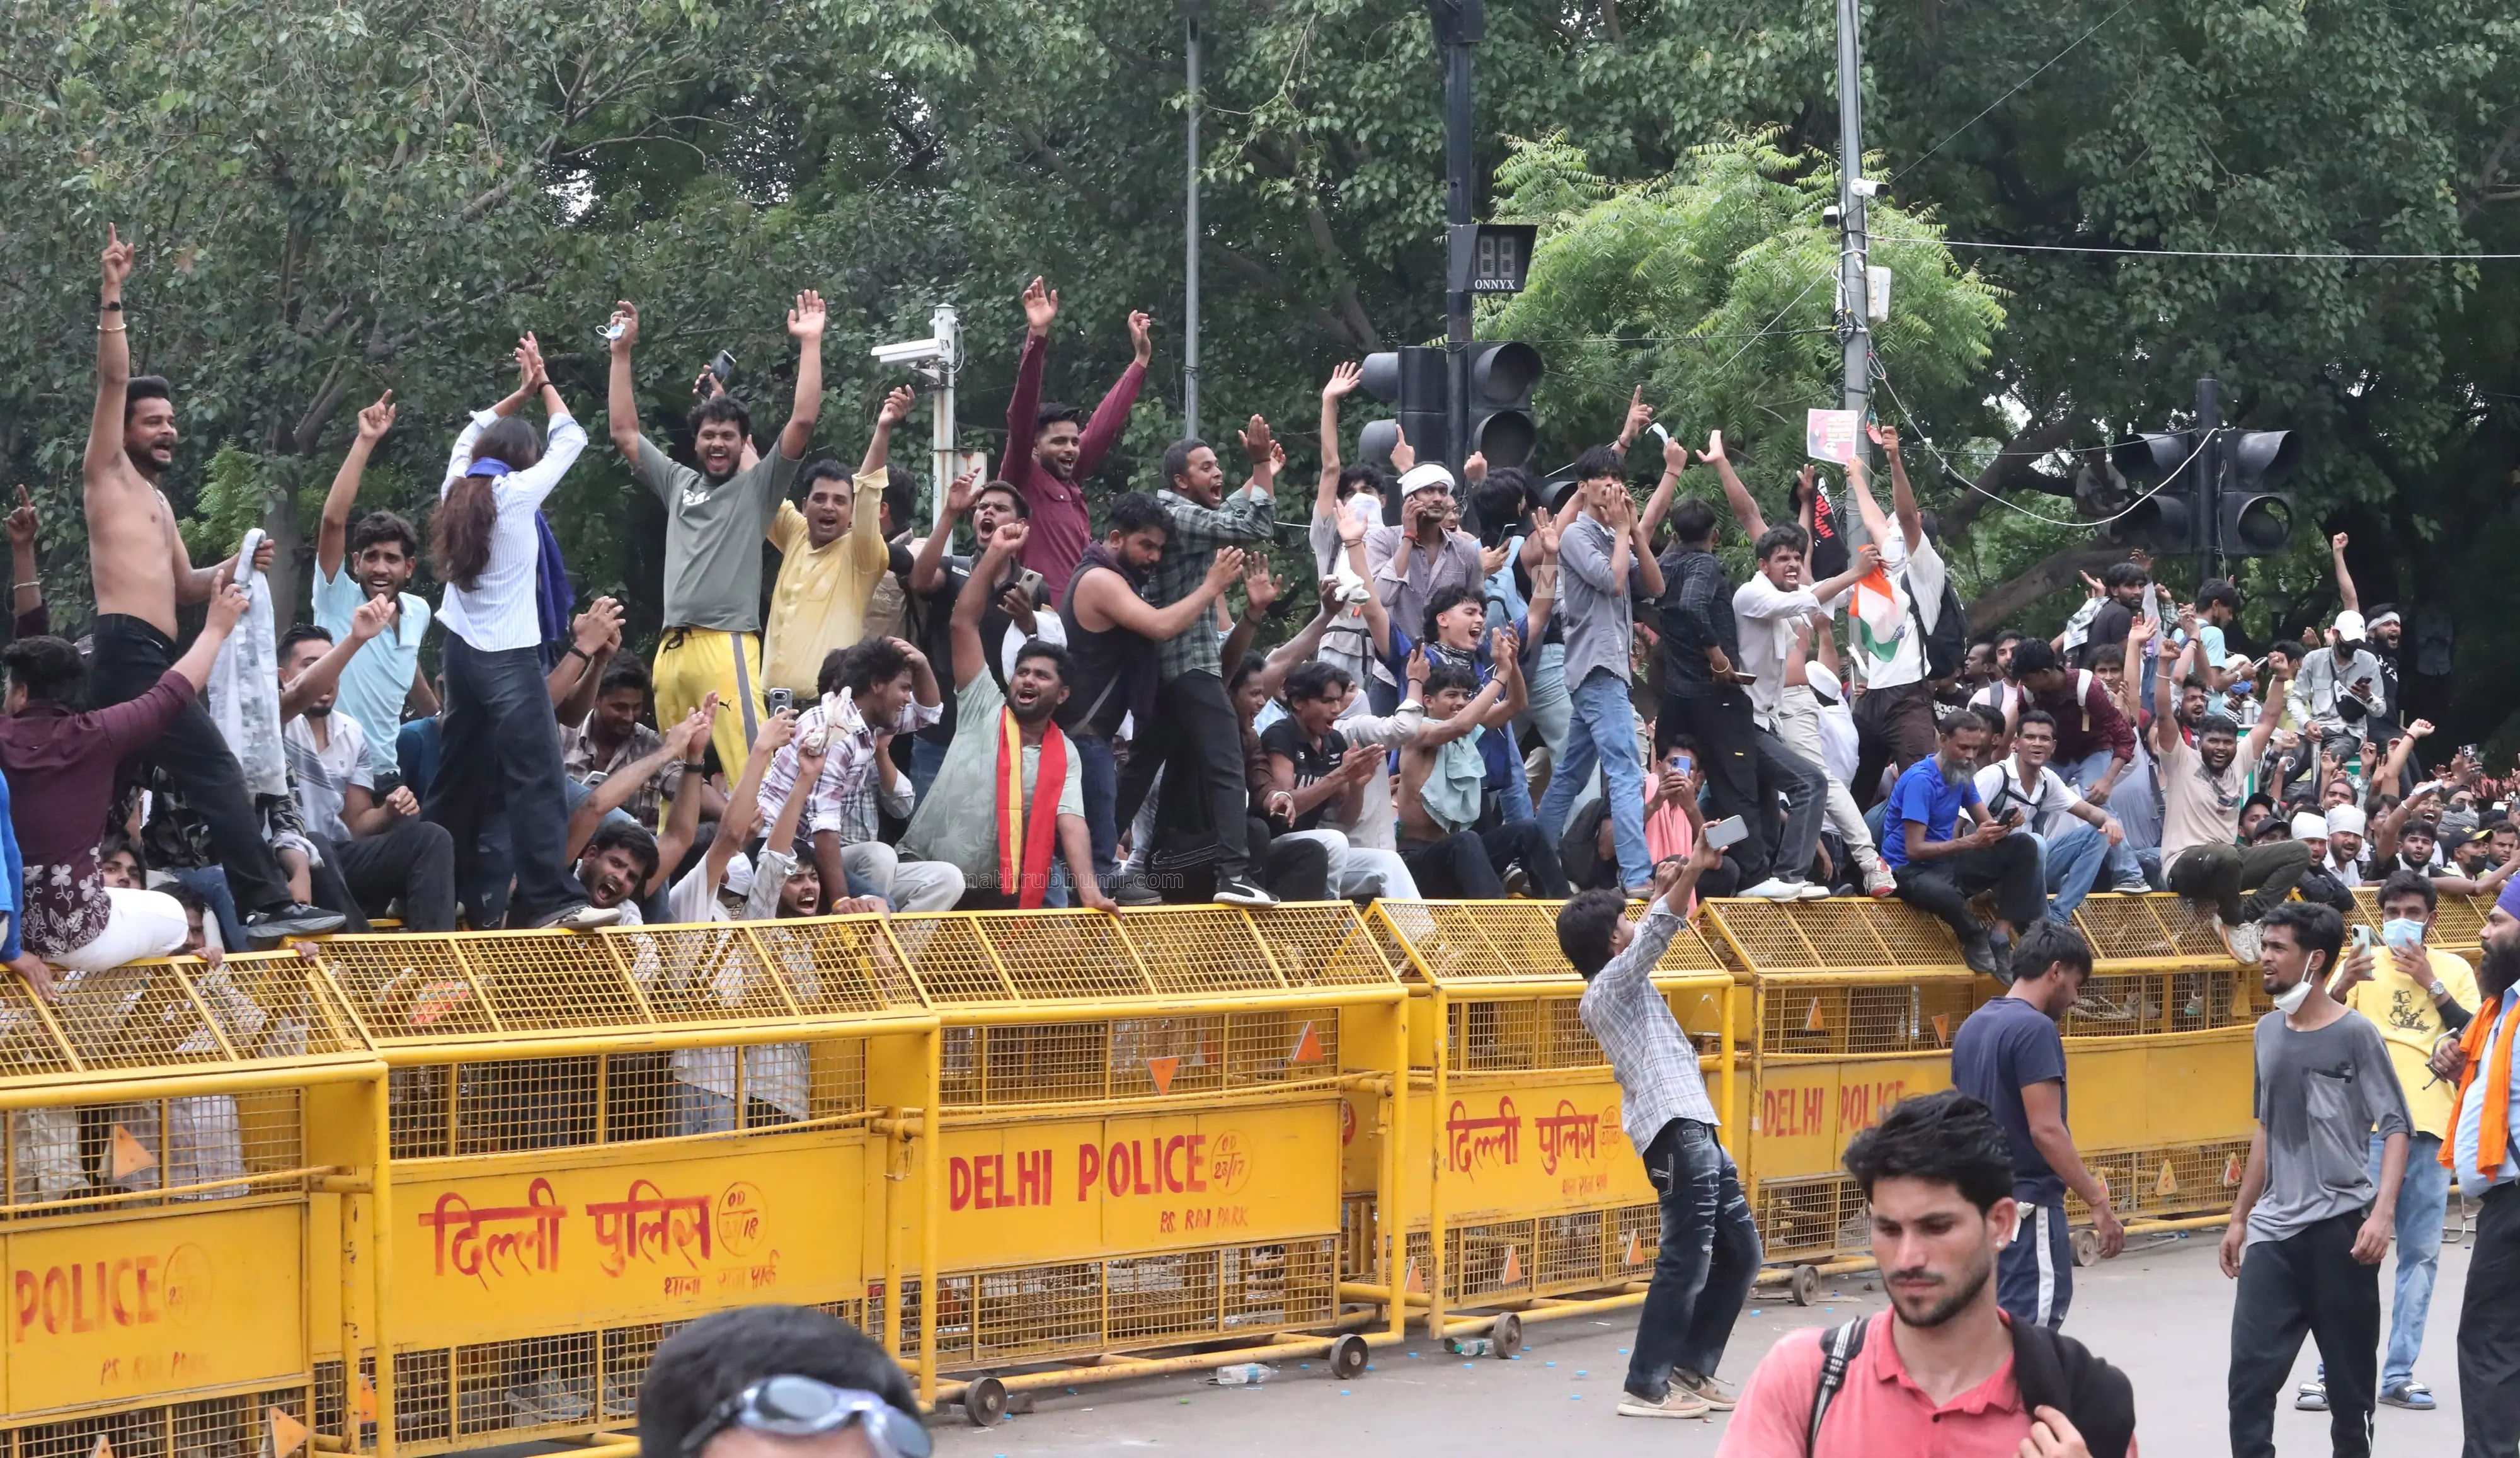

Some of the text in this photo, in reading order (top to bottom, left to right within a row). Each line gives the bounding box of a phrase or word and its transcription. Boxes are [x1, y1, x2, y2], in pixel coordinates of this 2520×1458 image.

[1475, 279, 1515, 290] ONNYX
[1446, 1096, 1598, 1183] दिल्ली पुलिस
[1763, 1087, 1824, 1138] DELHI
[949, 1134, 1207, 1211] DELHI POLICE
[418, 1177, 712, 1292] दिल्ली पुलिस
[1185, 1208, 1211, 1230] RAJ
[1217, 1205, 1249, 1229] PARK
[15, 1256, 159, 1343] POLICE
